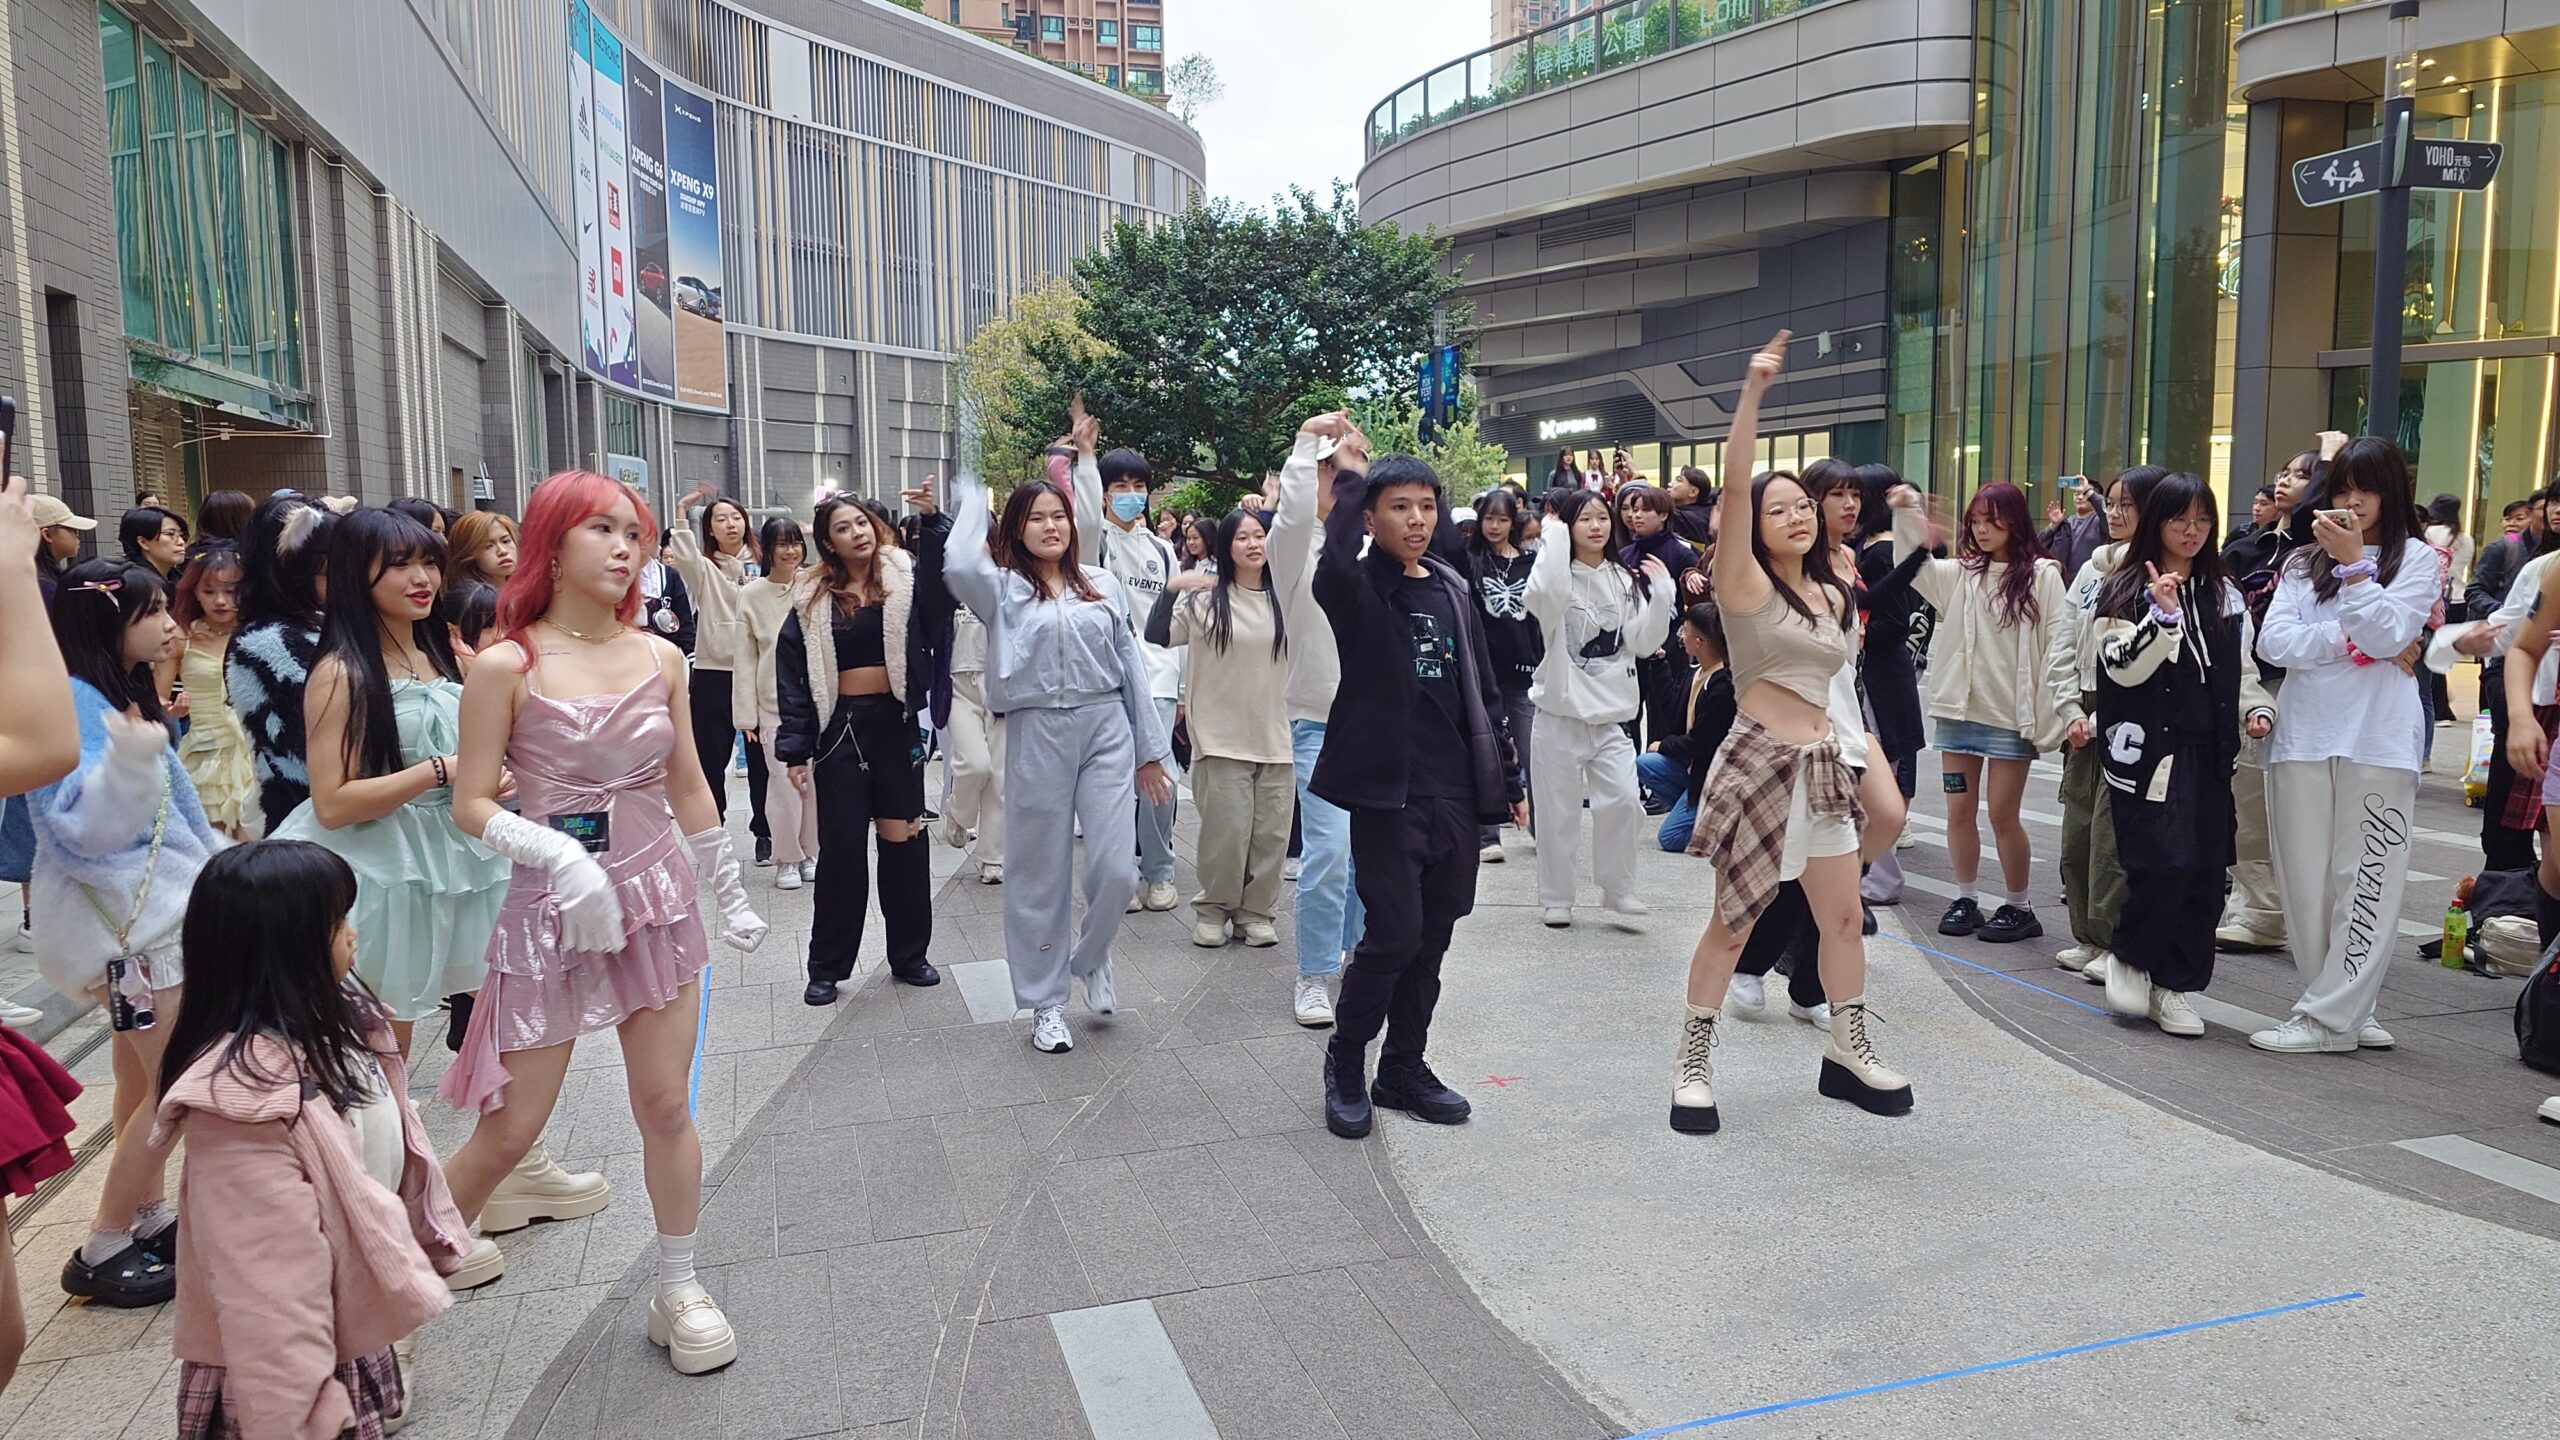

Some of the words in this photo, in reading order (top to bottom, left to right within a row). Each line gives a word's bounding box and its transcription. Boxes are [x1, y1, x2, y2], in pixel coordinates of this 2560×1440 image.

[1534, 16, 1645, 81] 棒棒糖公園
[631, 144, 654, 174] XPENG
[654, 160, 664, 180] G6
[2425, 146, 2454, 167] YOHO
[670, 168, 701, 195] XPENG
[702, 181, 714, 201] X9
[1128, 576, 1164, 592] EVENTS
[2110, 720, 2146, 765] C
